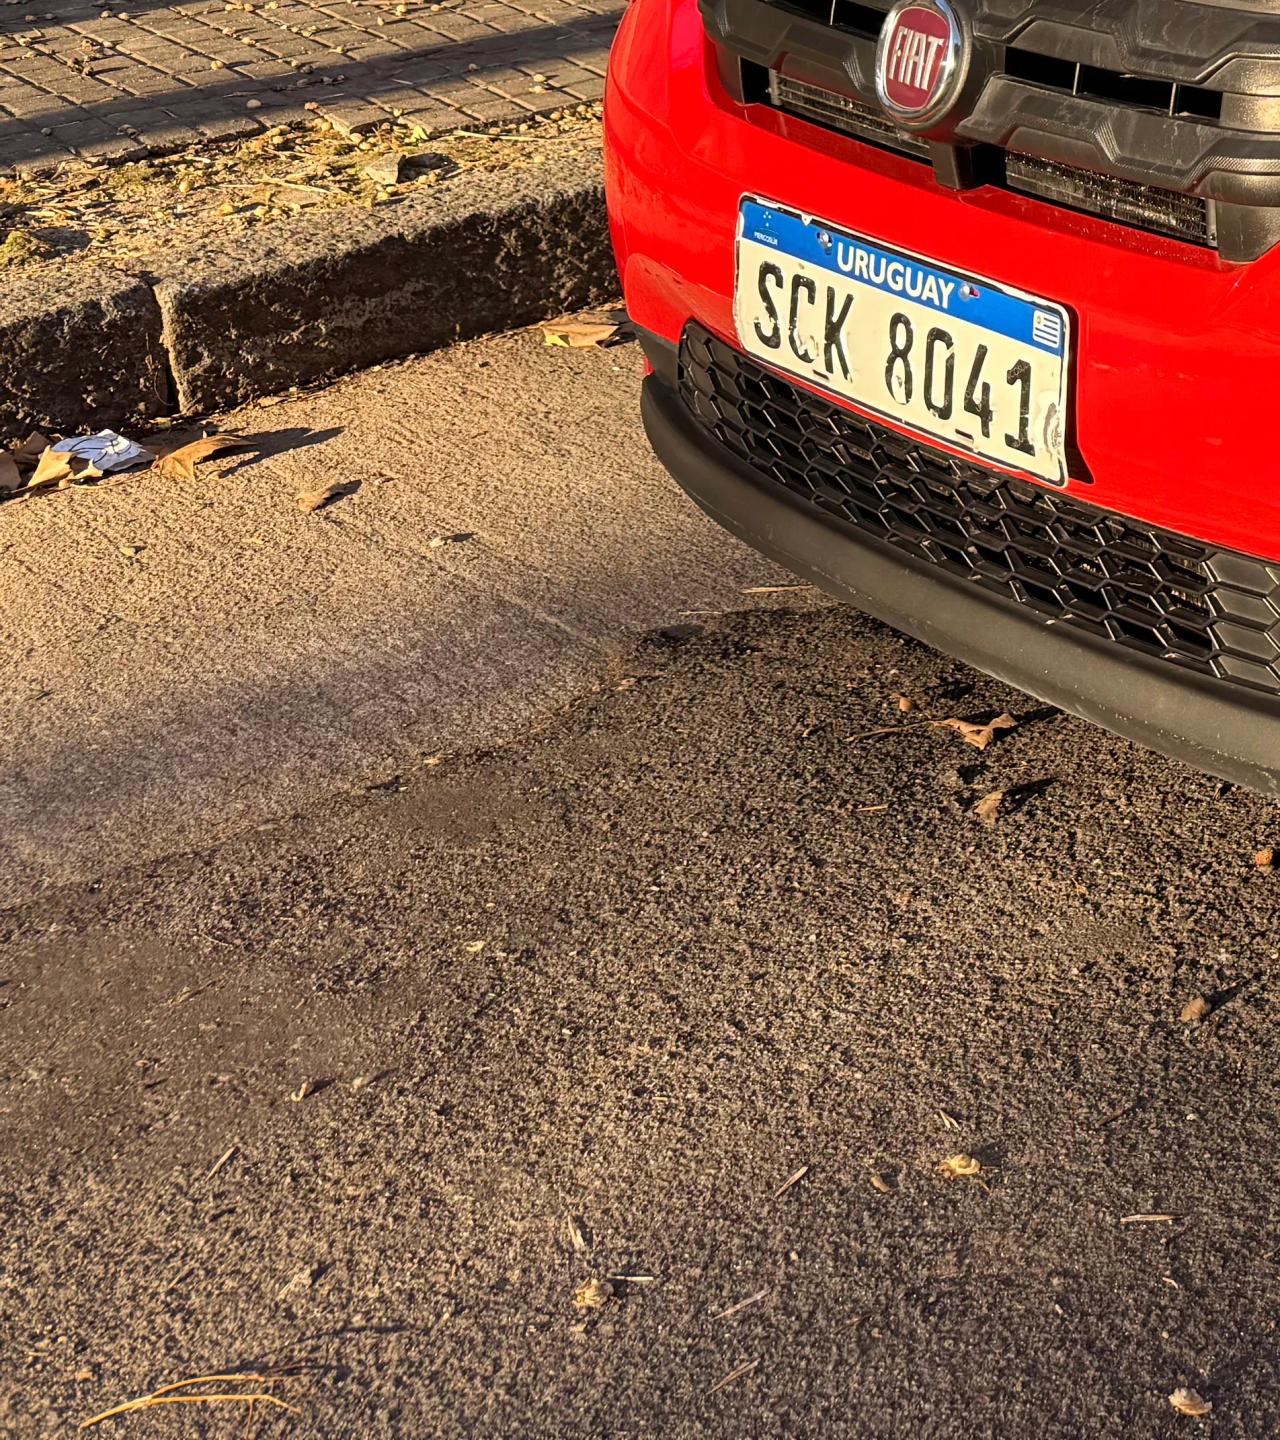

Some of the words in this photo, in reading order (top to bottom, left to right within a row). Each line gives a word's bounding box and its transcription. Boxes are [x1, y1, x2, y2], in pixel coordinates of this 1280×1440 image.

[888, 25, 945, 91] FIAT
[836, 242, 955, 309] URUGUAY
[754, 260, 854, 383] SCK
[885, 312, 1036, 457] 8041
